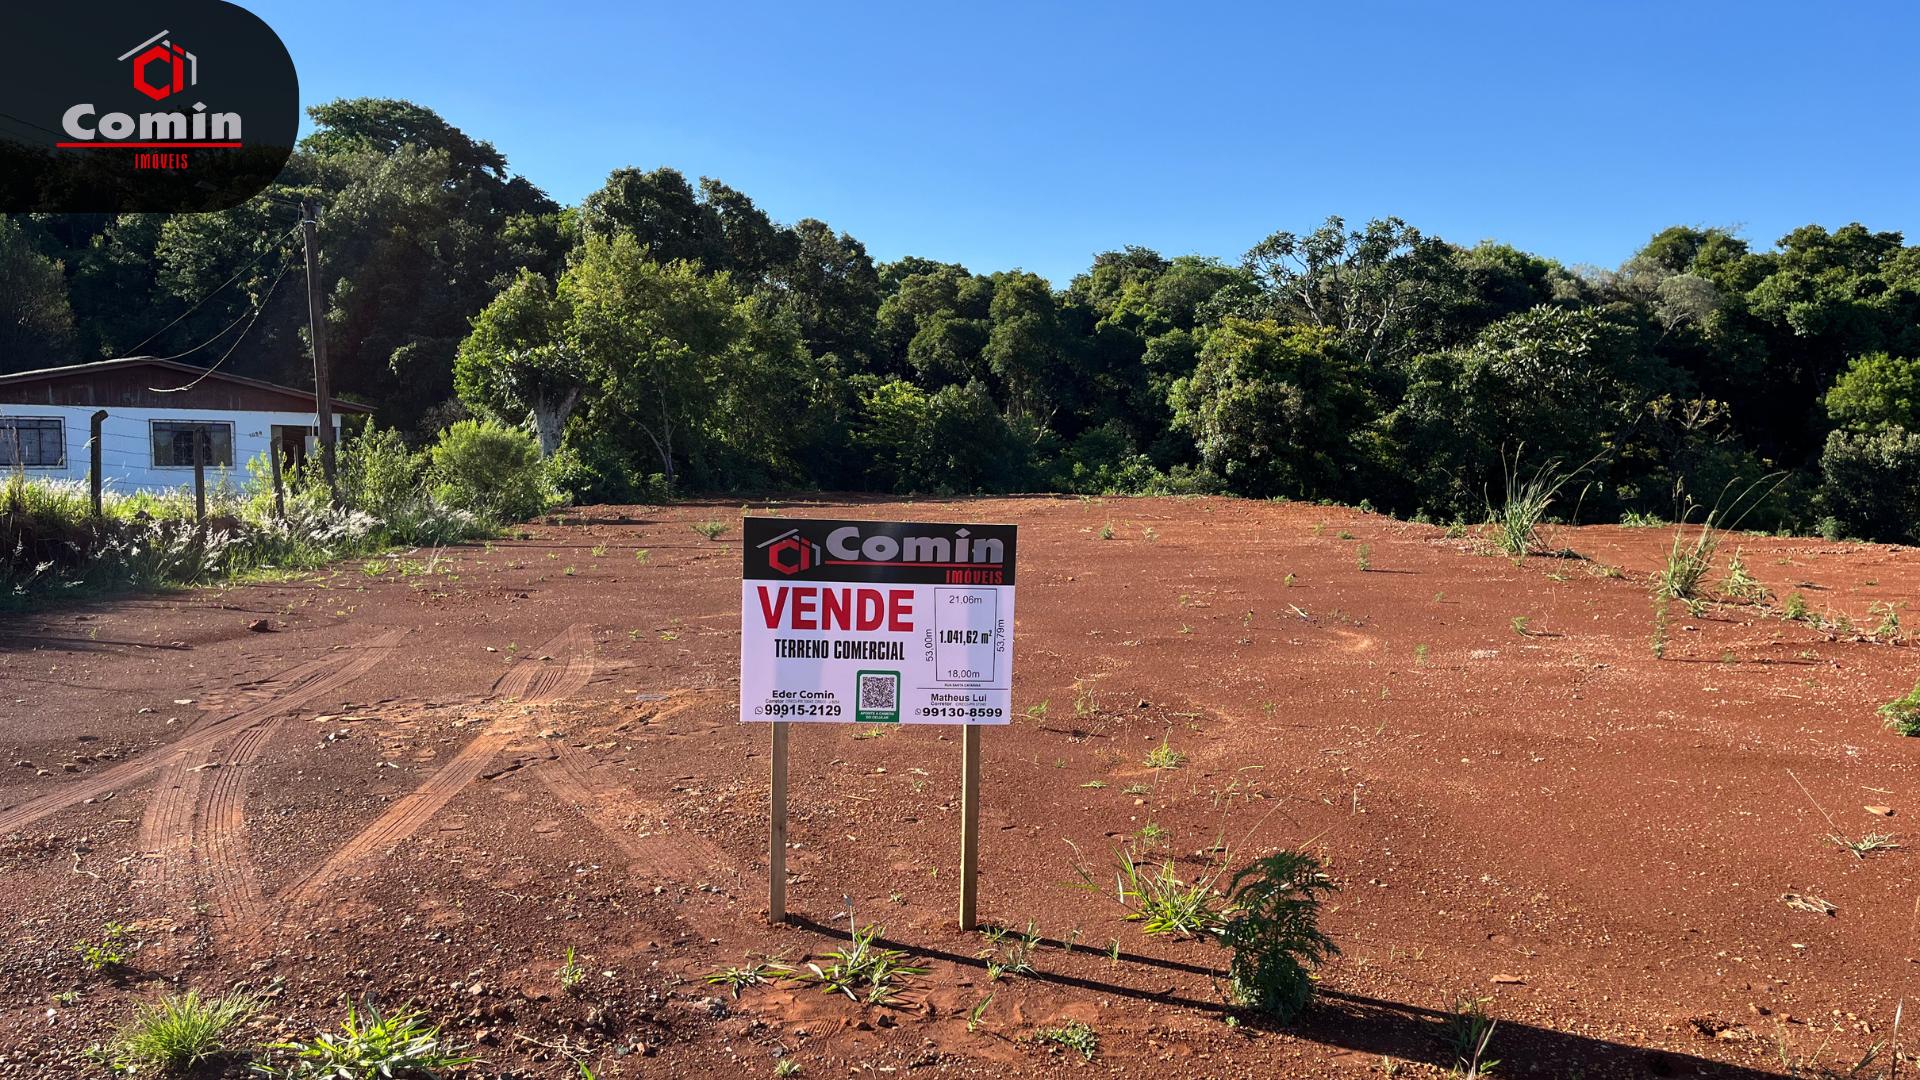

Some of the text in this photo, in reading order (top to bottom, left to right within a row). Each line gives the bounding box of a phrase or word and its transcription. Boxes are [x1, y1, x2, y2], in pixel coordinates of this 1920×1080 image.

[826, 526, 1004, 562] Comin
[949, 595, 983, 605] 21,06m
[756, 586, 915, 632] VENDE
[939, 630, 978, 645] 1.041,62
[996, 619, 1005, 653] 53,79m
[775, 638, 905, 661] TERRENO COMERCIAL
[925, 628, 934, 662] 53,00m
[948, 669, 980, 678] 18,00m
[772, 690, 835, 699] Eder Comin
[931, 693, 970, 702] Matheus
[764, 704, 841, 716] 99915-2129
[922, 707, 1002, 718] 99130-8599
